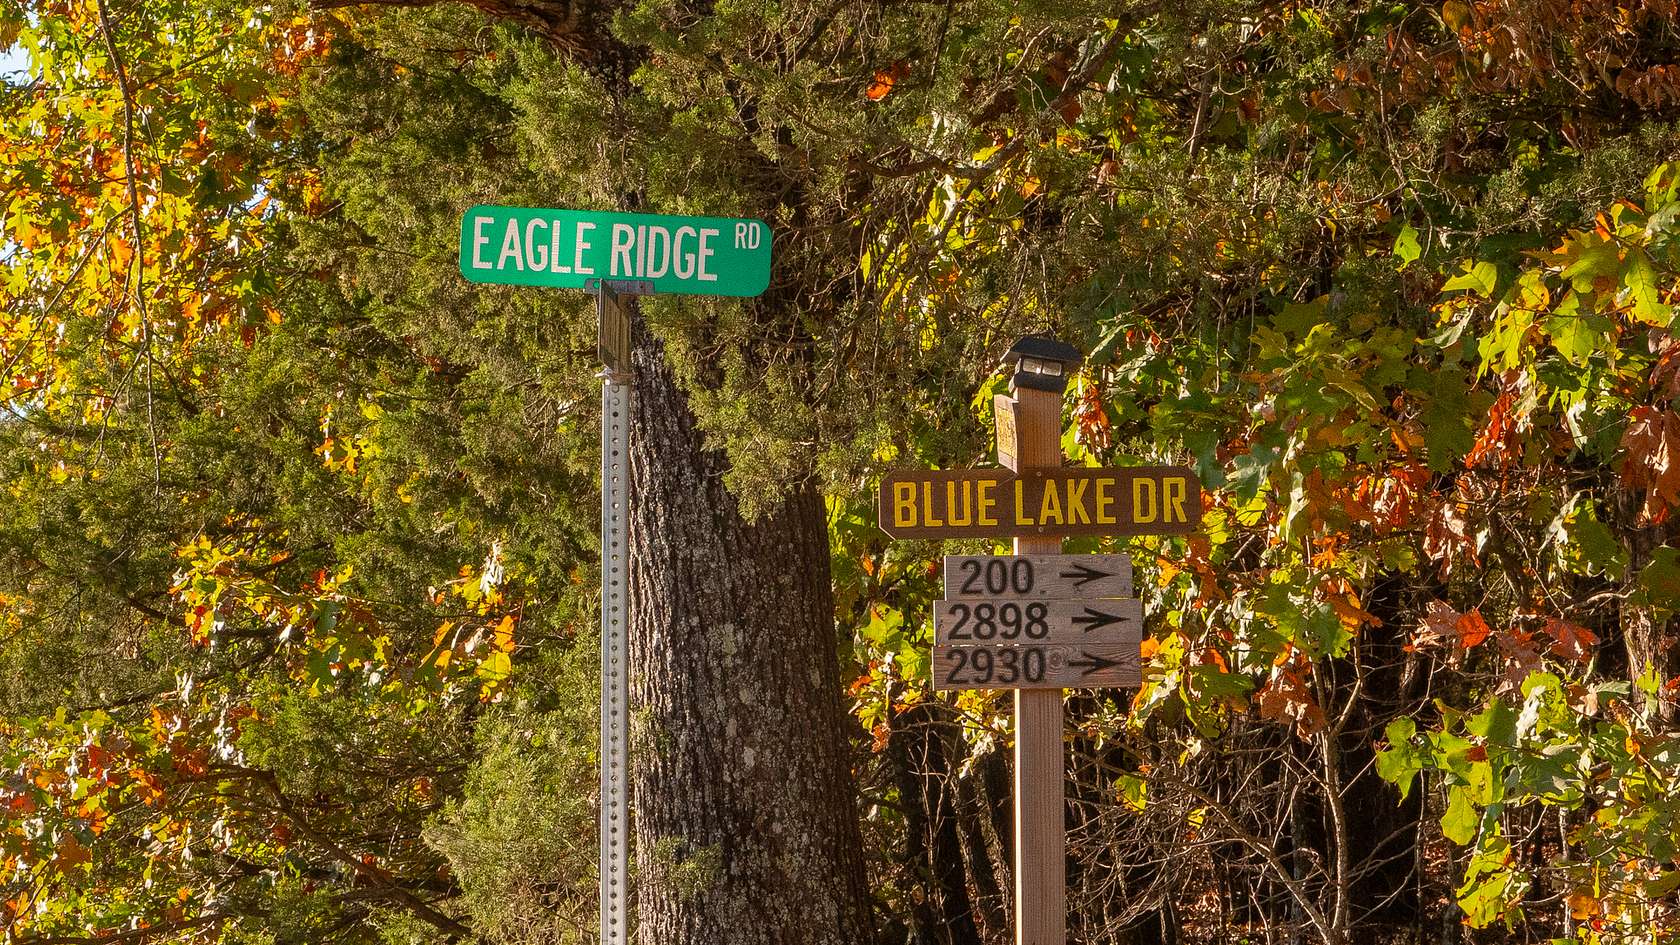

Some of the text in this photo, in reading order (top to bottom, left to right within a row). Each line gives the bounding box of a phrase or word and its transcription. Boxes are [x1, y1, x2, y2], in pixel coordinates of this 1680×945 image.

[472, 216, 761, 281] EAGLE RIDGE RD
[893, 477, 1187, 528] BLUE LAKE DR
[959, 558, 1035, 595] 200
[948, 602, 1049, 640] 2898
[945, 647, 1046, 684] 2930
